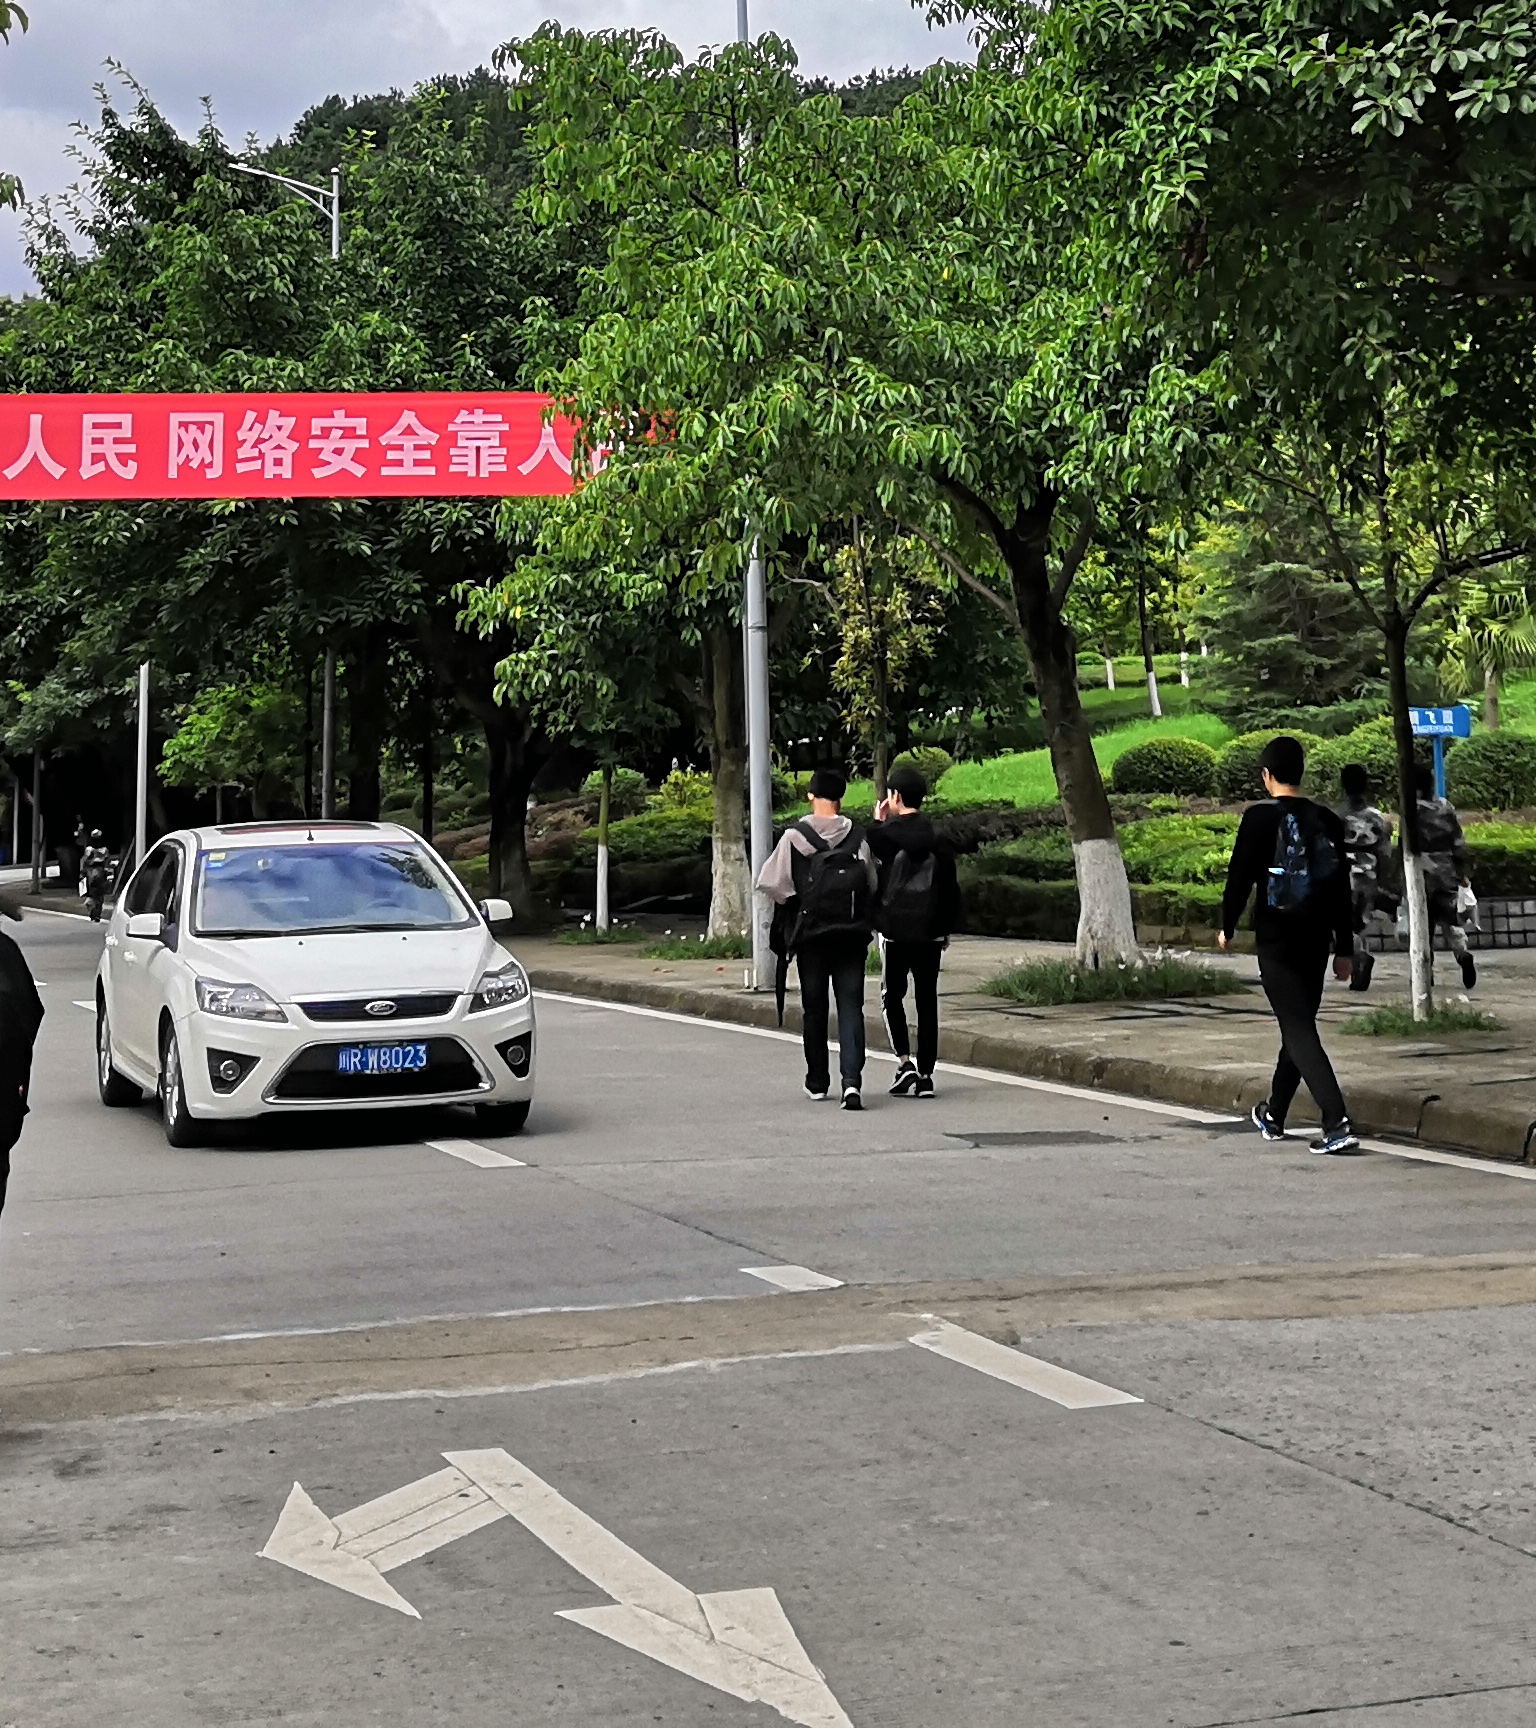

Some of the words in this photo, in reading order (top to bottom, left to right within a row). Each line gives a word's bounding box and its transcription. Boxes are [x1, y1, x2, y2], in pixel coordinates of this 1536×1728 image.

[166, 408, 636, 479] 网络安全靠人
